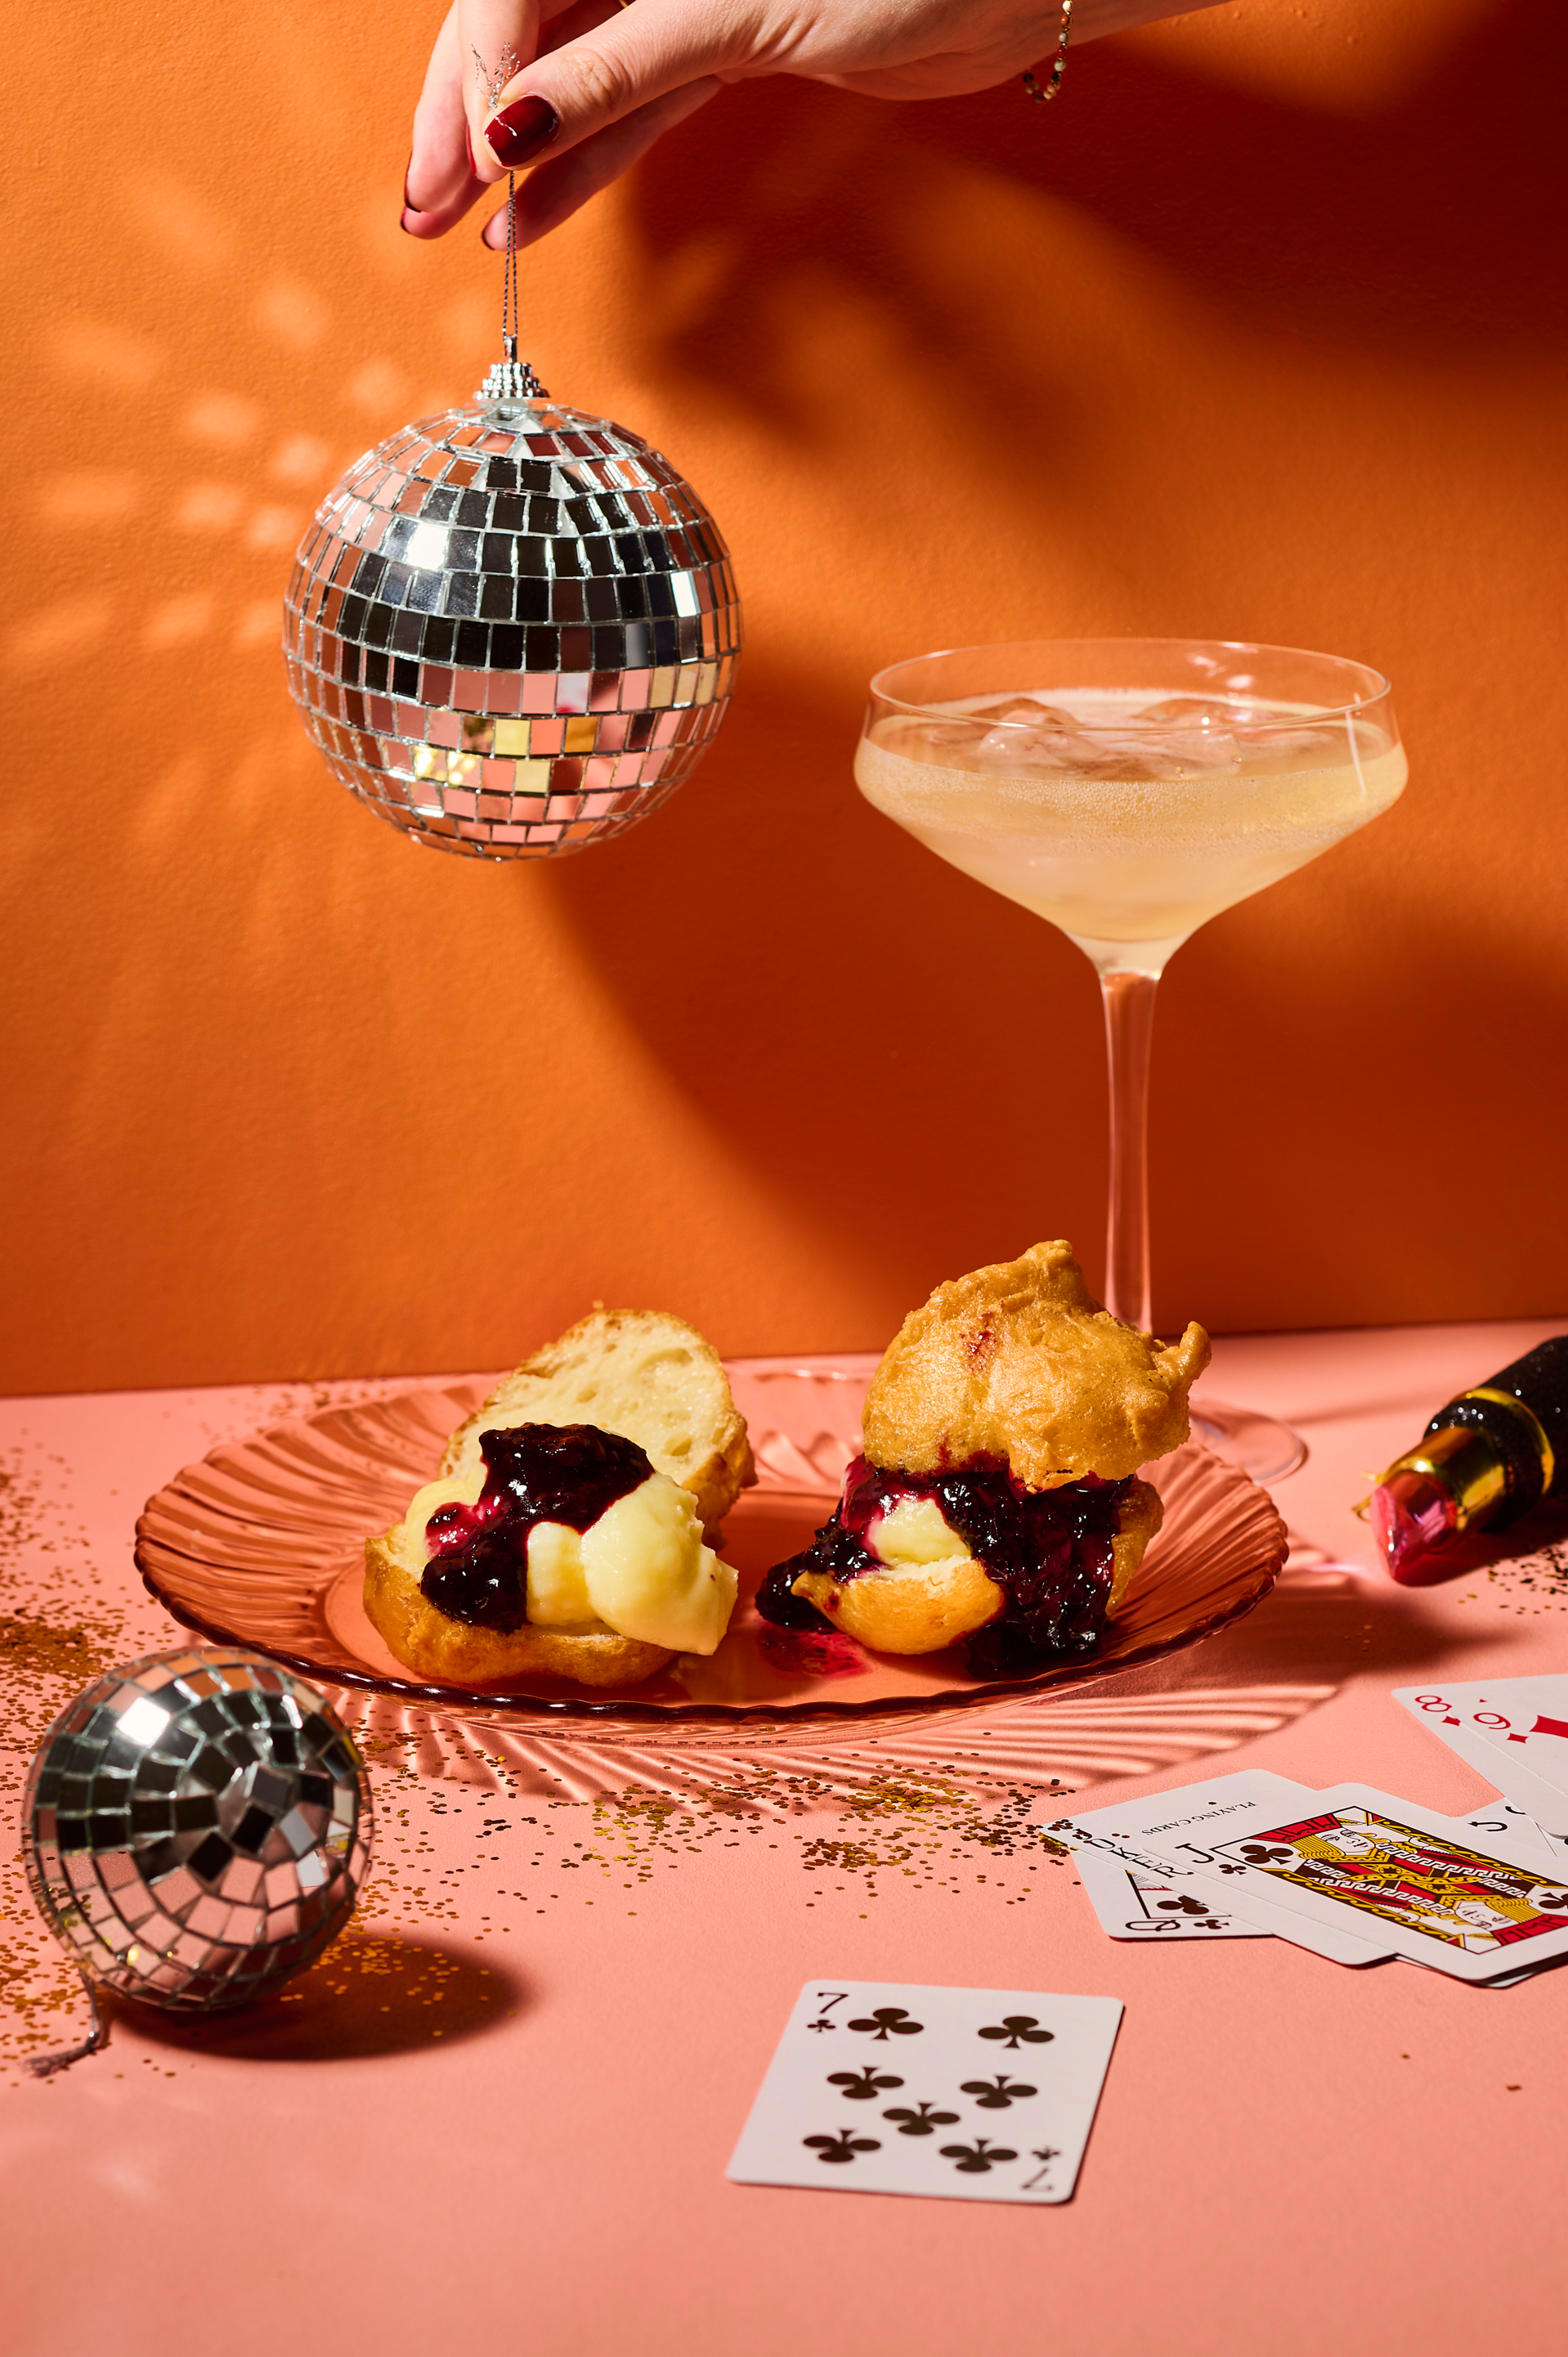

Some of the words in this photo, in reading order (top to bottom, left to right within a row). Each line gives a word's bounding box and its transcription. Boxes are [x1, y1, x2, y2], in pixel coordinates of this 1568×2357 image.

[1414, 1695, 1453, 1713] 8
[1472, 1712, 1512, 1730] 9
[1190, 1801, 1257, 1822] PLAYING
[1141, 1819, 1192, 1835] CARDS
[1072, 1828, 1194, 1879] JOKER
[1174, 1842, 1215, 1864] J
[1125, 1919, 1181, 1932] Q
[818, 1992, 849, 2014] 7
[1020, 2167, 1055, 2192] 7
